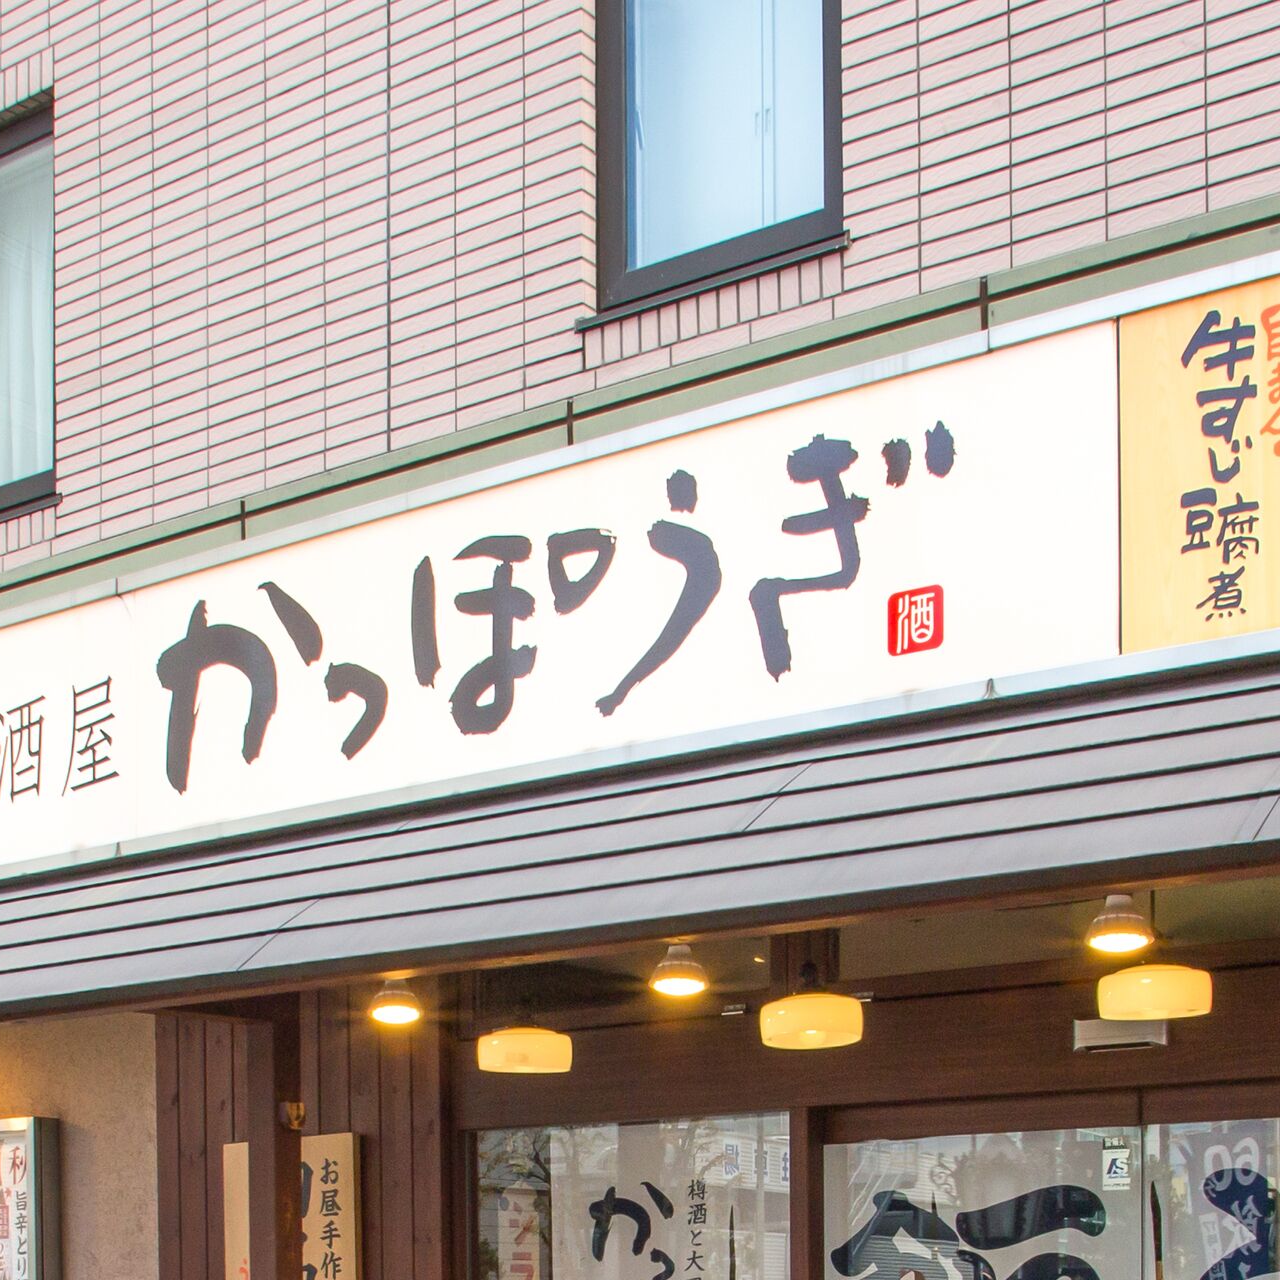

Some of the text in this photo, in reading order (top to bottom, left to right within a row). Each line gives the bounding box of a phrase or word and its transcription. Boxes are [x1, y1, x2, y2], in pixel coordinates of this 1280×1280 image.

[156, 419, 957, 795] かっぽうぎ
[894, 590, 939, 655] 酒
[1180, 308, 1261, 623] 牛すじ豆腐煮
